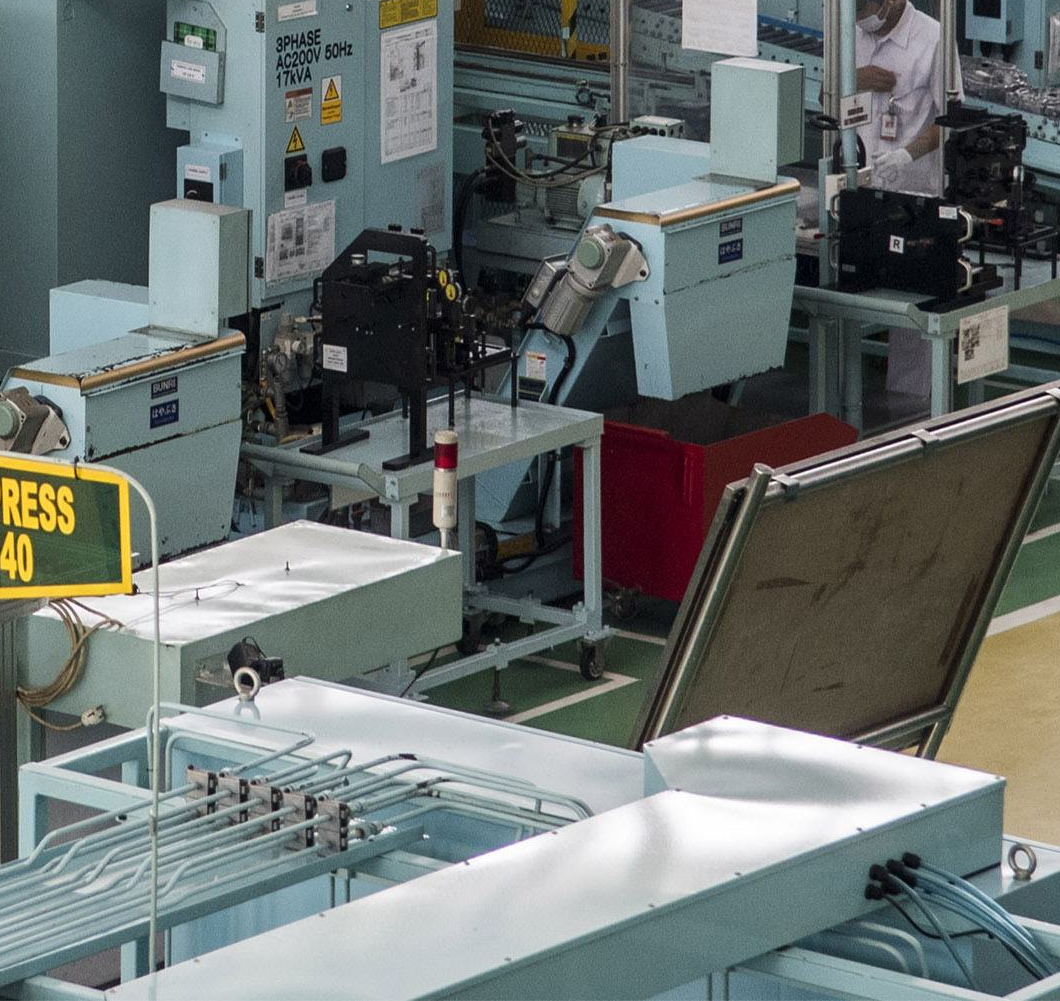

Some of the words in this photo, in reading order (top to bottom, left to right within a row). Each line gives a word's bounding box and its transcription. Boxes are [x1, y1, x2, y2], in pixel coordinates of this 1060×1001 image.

[276, 29, 321, 53] 3PHASE
[276, 48, 321, 71] AC200V
[325, 40, 353, 61] 50Hz
[276, 66, 312, 88] 17kVA
[893, 238, 900, 249] R
[152, 379, 176, 393] BUNRI
